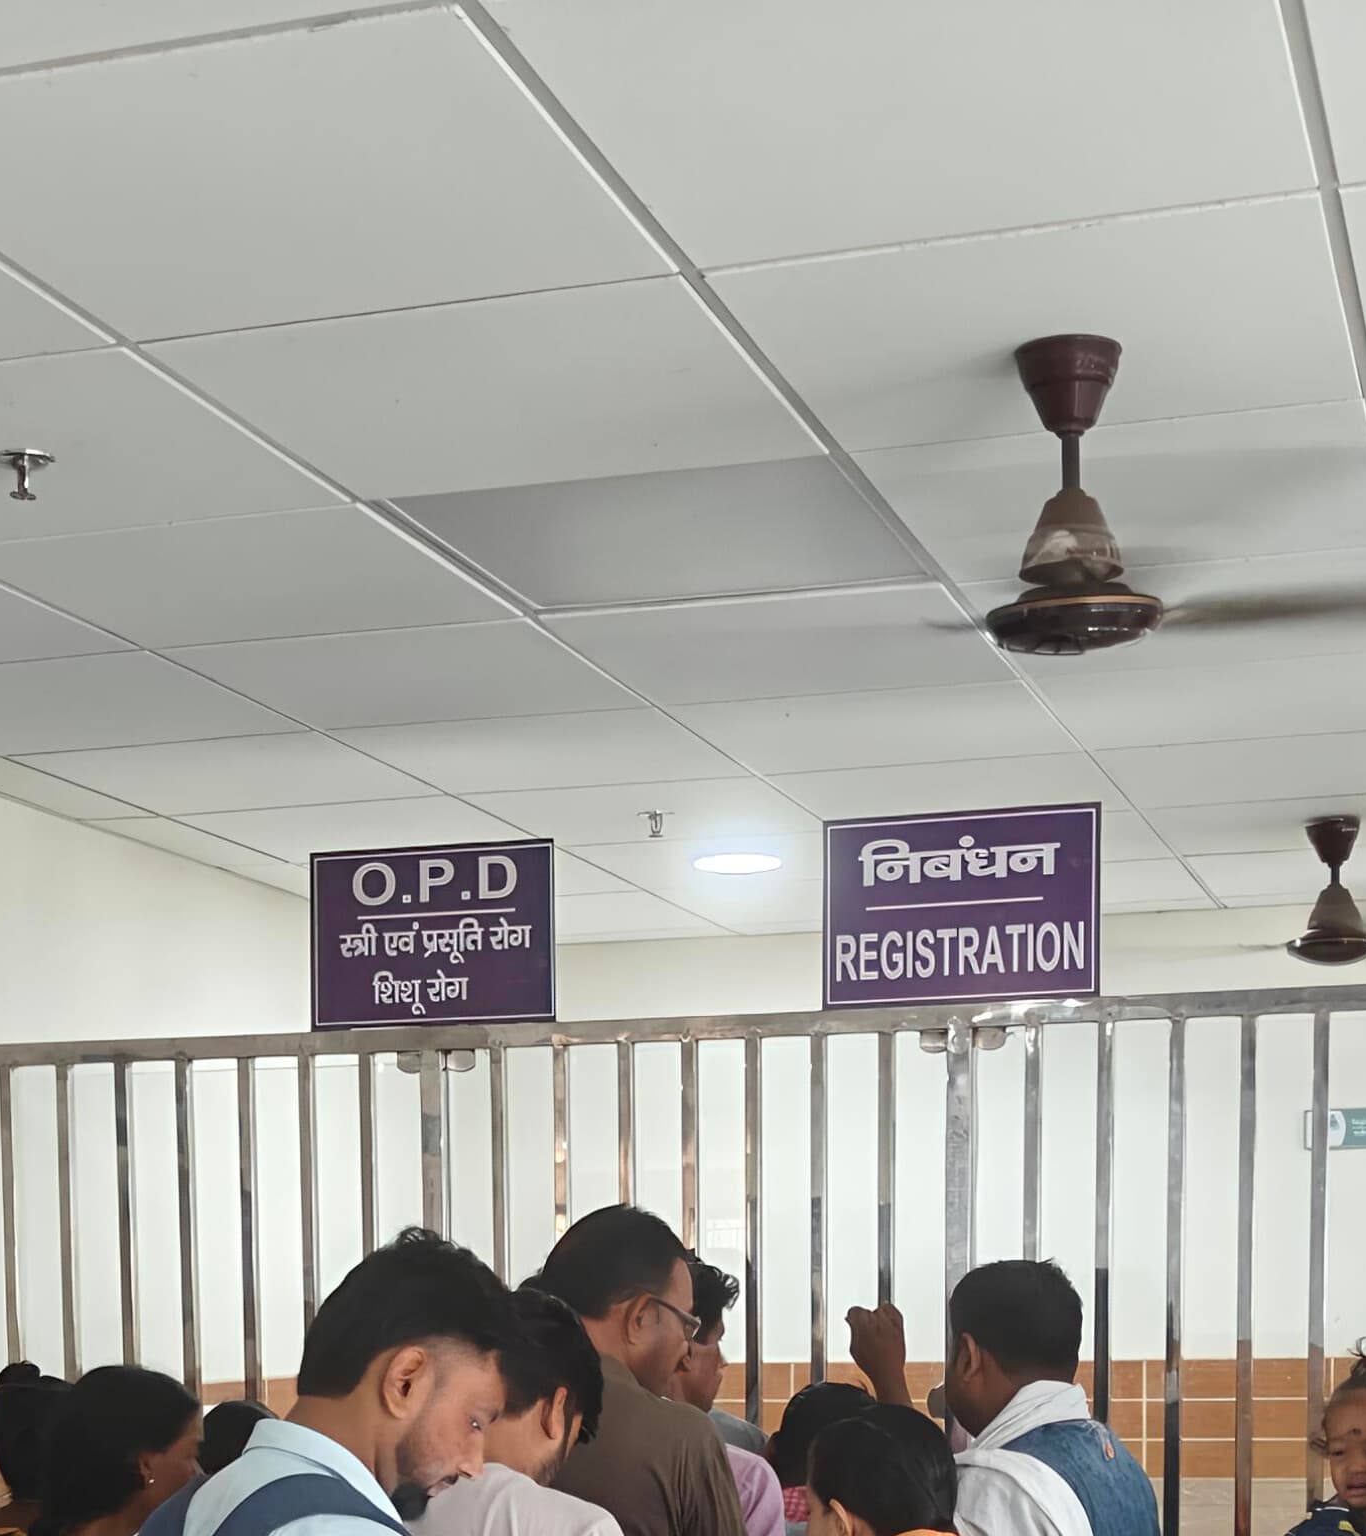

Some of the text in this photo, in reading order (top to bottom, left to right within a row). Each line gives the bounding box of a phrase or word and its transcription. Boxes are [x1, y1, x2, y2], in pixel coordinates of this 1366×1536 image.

[857, 835, 1061, 887] निबंधन
[339, 917, 532, 963] स्त्री एवं प्रसूति रोग
[835, 921, 1084, 982] REGISTRATION
[372, 968, 469, 1015] शिशू रोग
